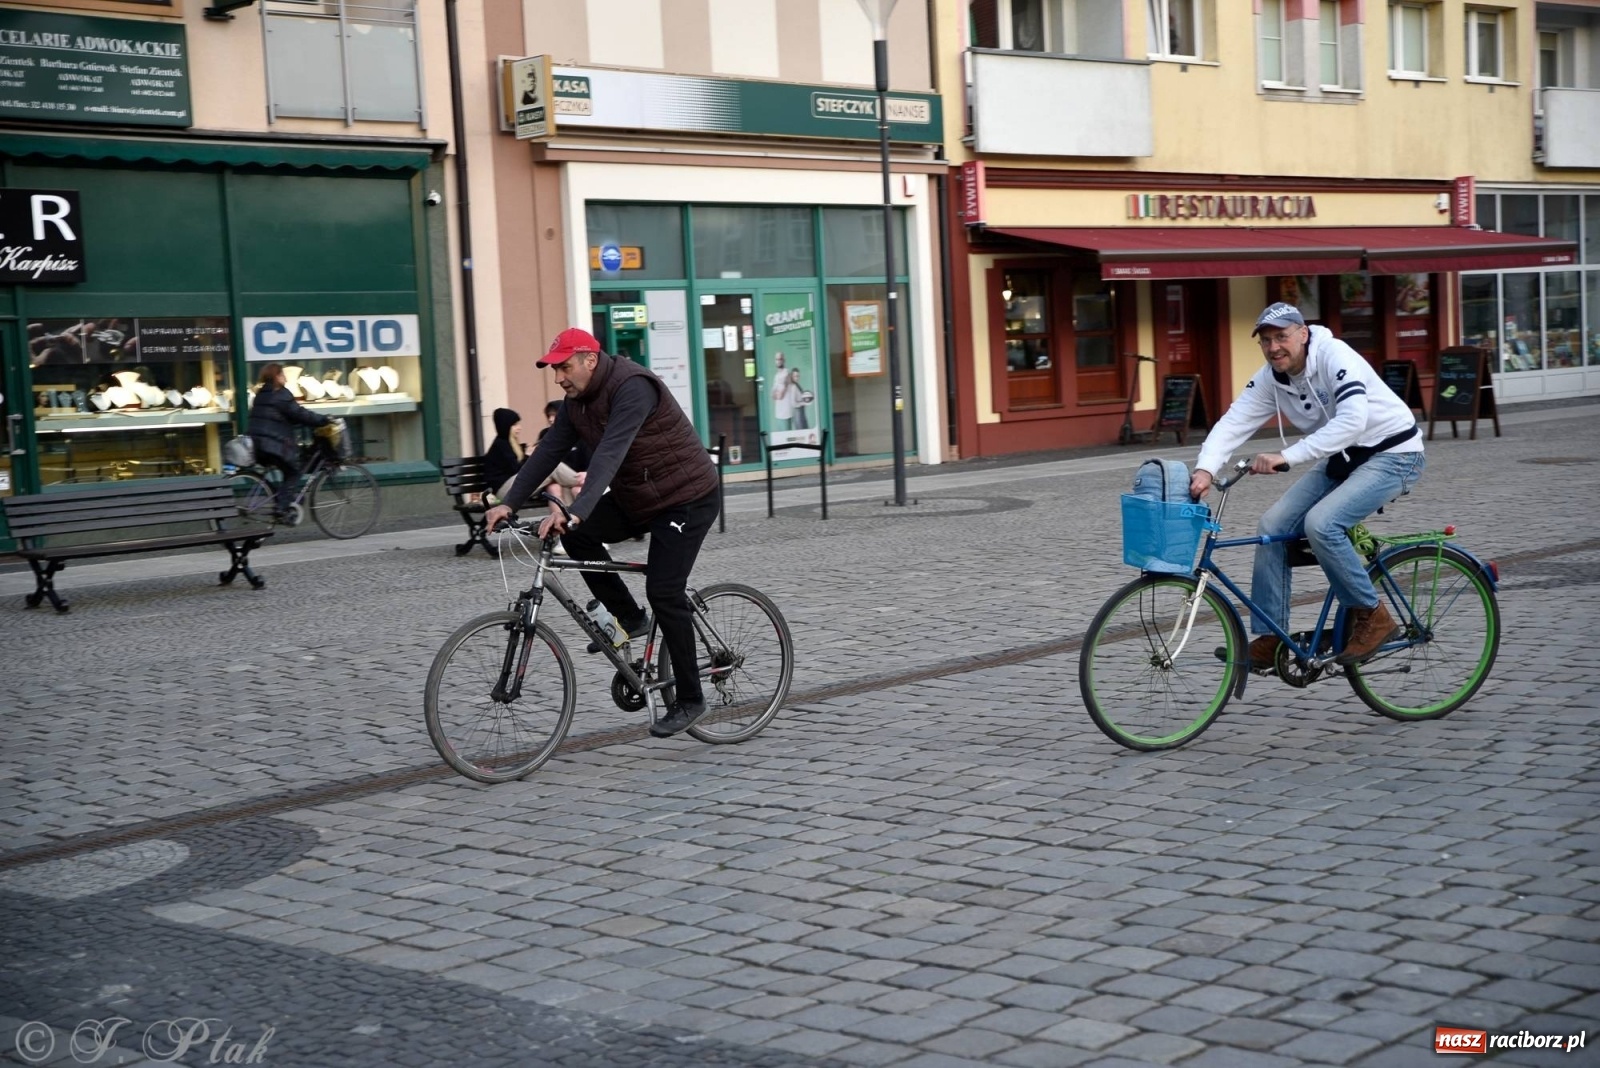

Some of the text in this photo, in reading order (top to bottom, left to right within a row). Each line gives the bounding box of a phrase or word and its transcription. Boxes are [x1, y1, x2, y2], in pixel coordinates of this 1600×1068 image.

[73, 36, 182, 56] ADWOKACKIE
[552, 79, 590, 93] KASA
[816, 97, 926, 119] STEFCZYK NANSE
[1155, 194, 1317, 219] RESTAURACJA
[0, 245, 79, 280] Karpisz
[765, 307, 806, 327] GRAMY
[253, 319, 404, 355] CASIO
[142, 345, 178, 354] SERWIS
